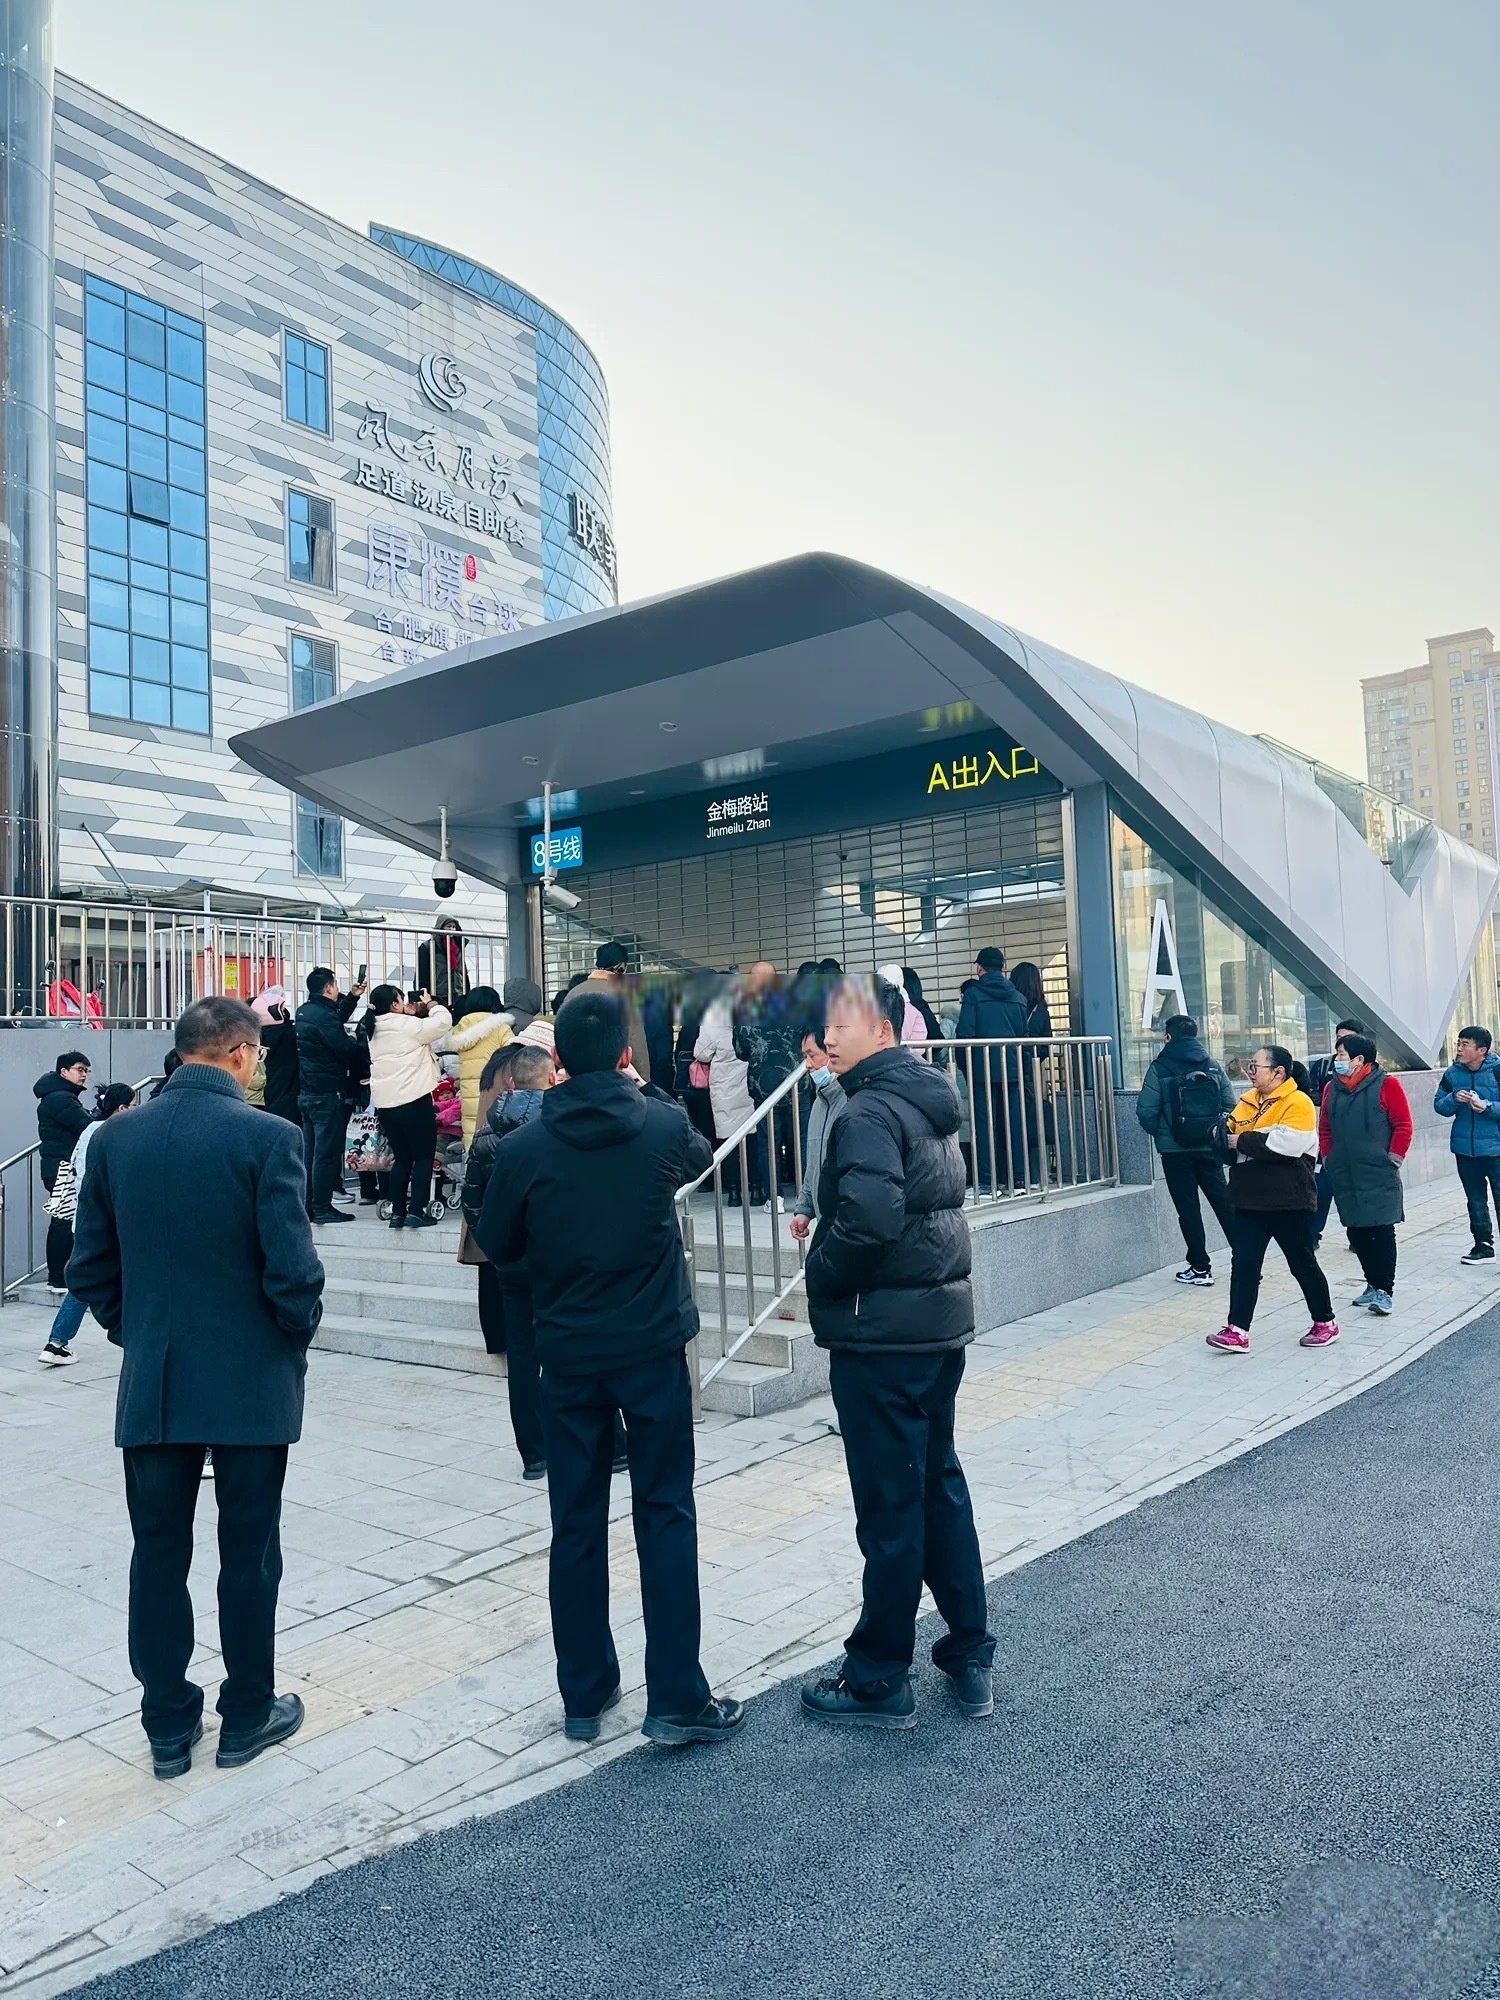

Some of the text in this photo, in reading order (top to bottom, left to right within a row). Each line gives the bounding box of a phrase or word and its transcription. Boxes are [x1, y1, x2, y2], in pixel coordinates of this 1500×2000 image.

[706, 791, 769, 822] 金梅路站
[706, 818, 771, 838] Jinmeilu Zhan
[534, 835, 580, 867] 8号线
[1141, 898, 1189, 1029] A
